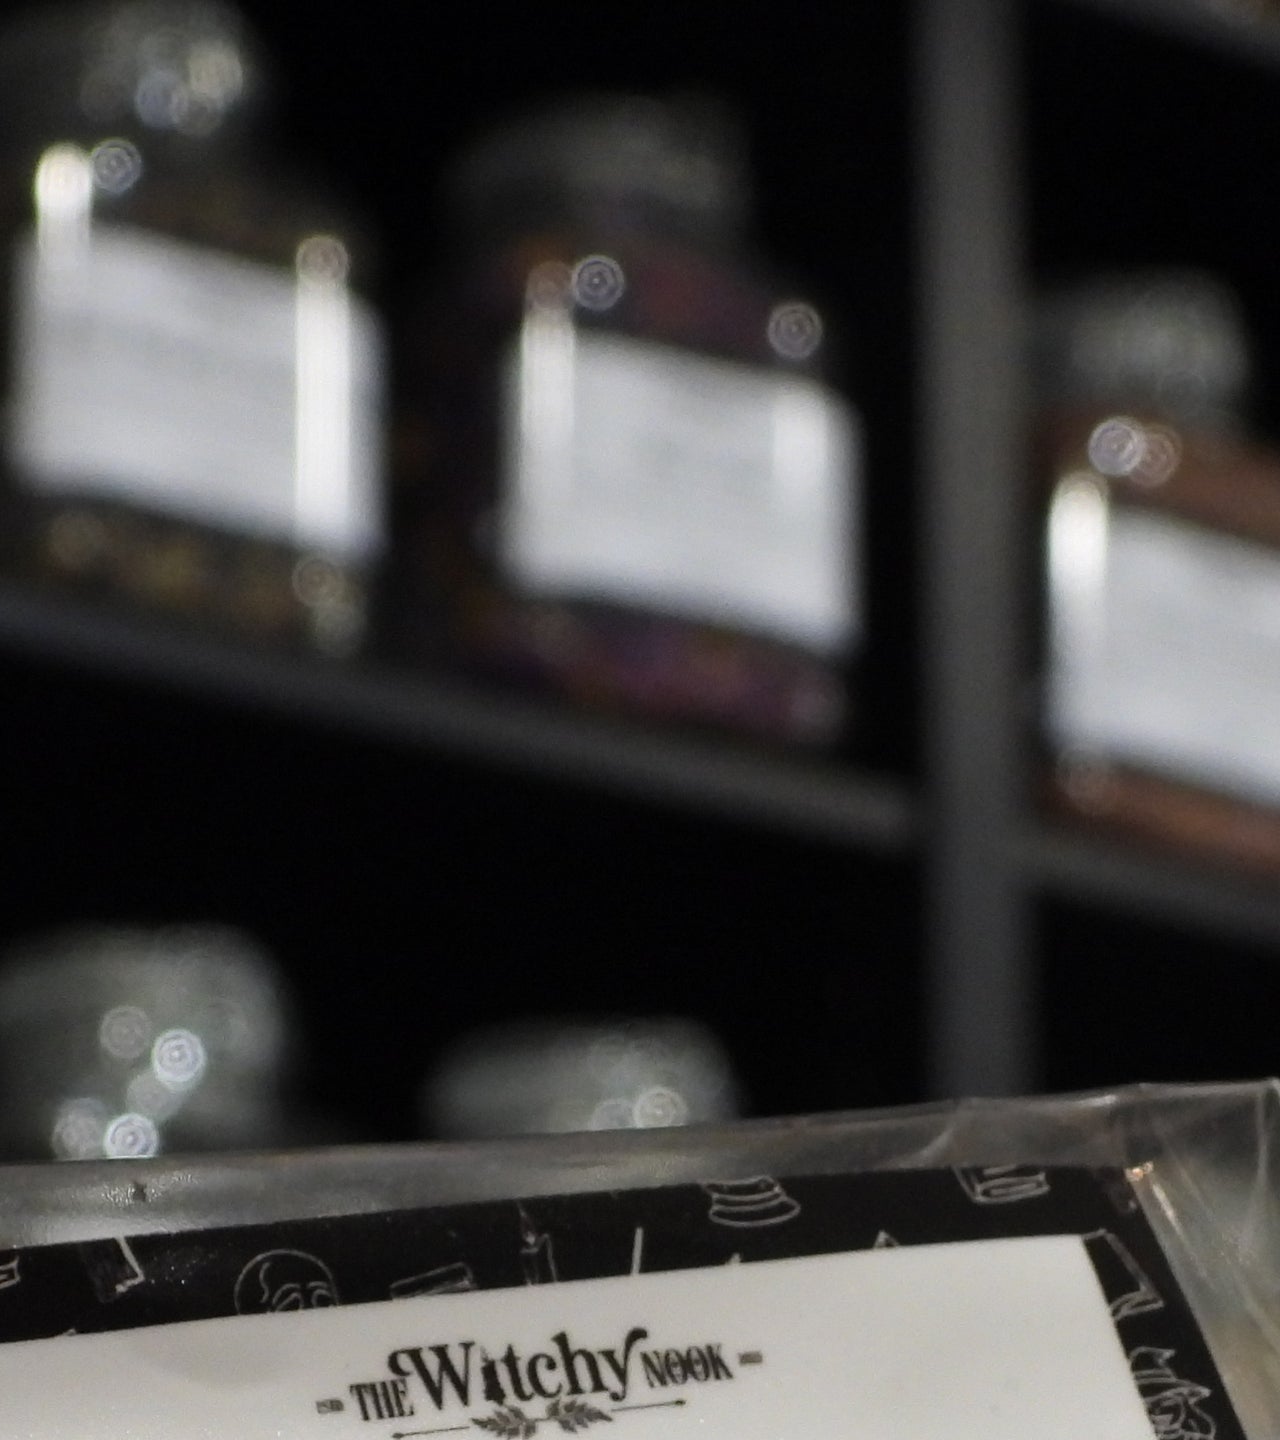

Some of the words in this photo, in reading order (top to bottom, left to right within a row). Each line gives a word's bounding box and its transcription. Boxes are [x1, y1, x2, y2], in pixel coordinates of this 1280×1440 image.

[349, 1378, 415, 1422] THE
[387, 1327, 649, 1411] Witchy
[640, 1342, 734, 1389] NOOK
